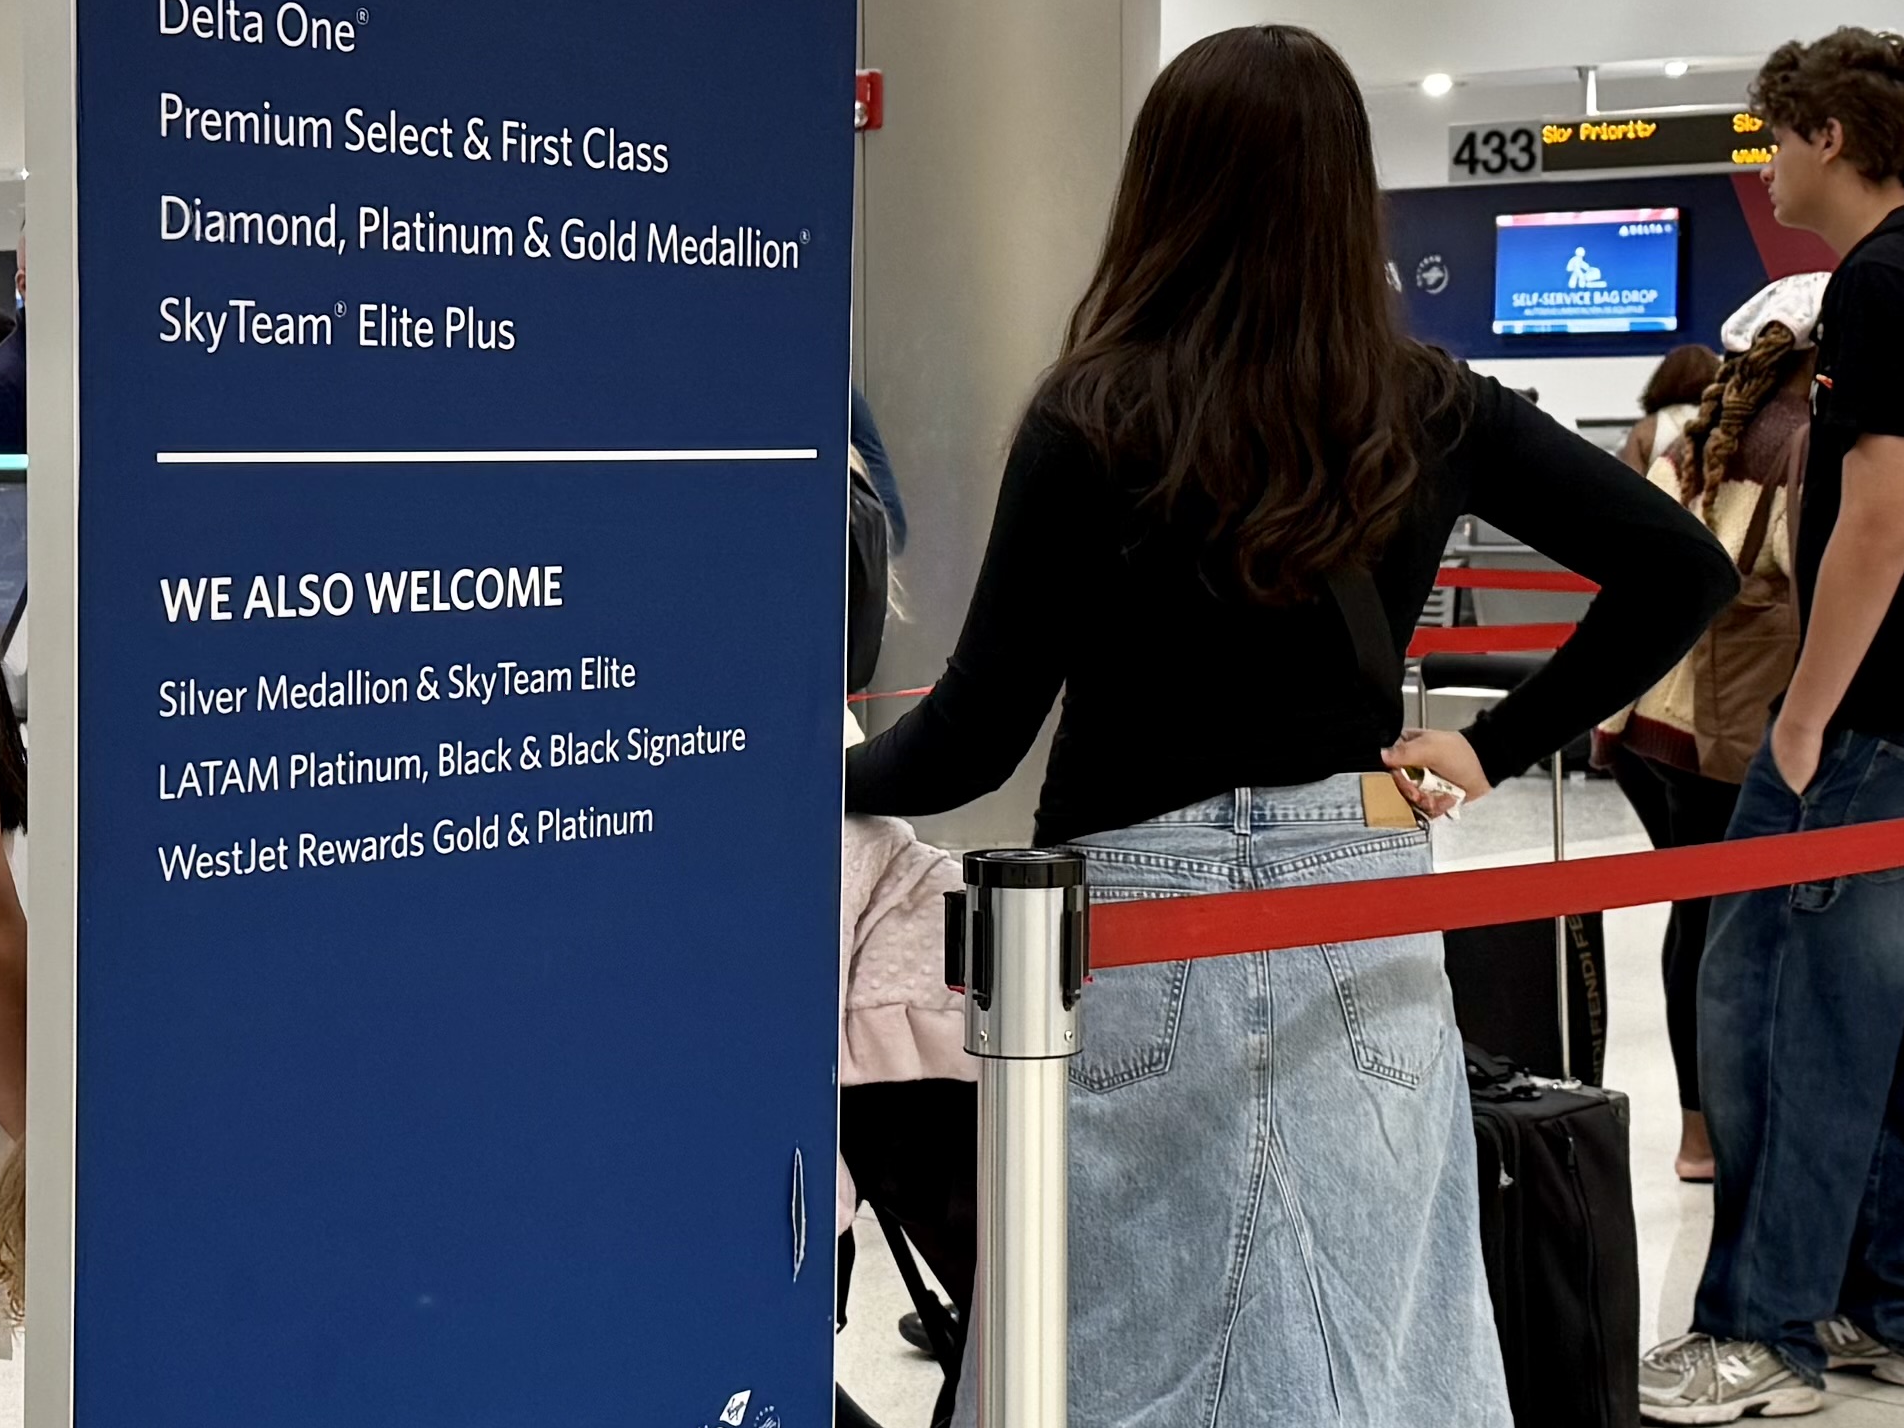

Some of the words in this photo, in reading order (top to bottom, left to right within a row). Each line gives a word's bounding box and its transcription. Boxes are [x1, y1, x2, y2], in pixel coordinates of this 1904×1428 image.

[161, 93, 331, 148] Premium
[345, 108, 453, 158] Select
[464, 118, 491, 160] &
[503, 121, 572, 166] First
[583, 127, 668, 172] Class
[1453, 128, 1536, 174] 433
[1542, 125, 1573, 144] Sky
[1580, 120, 1656, 141] Priority
[161, 196, 345, 255] Diamond,
[360, 207, 512, 256] Platinum
[524, 216, 551, 257] &
[561, 219, 636, 261] Gold
[360, 304, 433, 347] Elite
[446, 306, 514, 349] Plus
[1512, 291, 1590, 307] SELF-SERVICE
[1594, 290, 1620, 304] BAG
[1622, 289, 1658, 304] DROP
[161, 577, 232, 622] WE
[244, 573, 353, 619] ALSO
[365, 566, 562, 613] WELCOME
[160, 679, 247, 717] Silver
[258, 670, 407, 711] Medallion
[417, 666, 440, 701] &
[449, 662, 571, 704] SkyTeam
[582, 656, 635, 690] Elite
[160, 756, 278, 799] LATAM
[291, 751, 428, 789] Platinum,
[439, 738, 511, 776] Black
[520, 736, 542, 770] &
[551, 730, 619, 766] Black
[628, 725, 745, 766] Signature
[159, 838, 288, 881] WestJet
[299, 823, 424, 868] Rewards
[433, 814, 498, 854] Gold
[508, 813, 529, 846] &
[539, 807, 652, 843] Platinum
[1579, 952, 1603, 1035] FENDI
